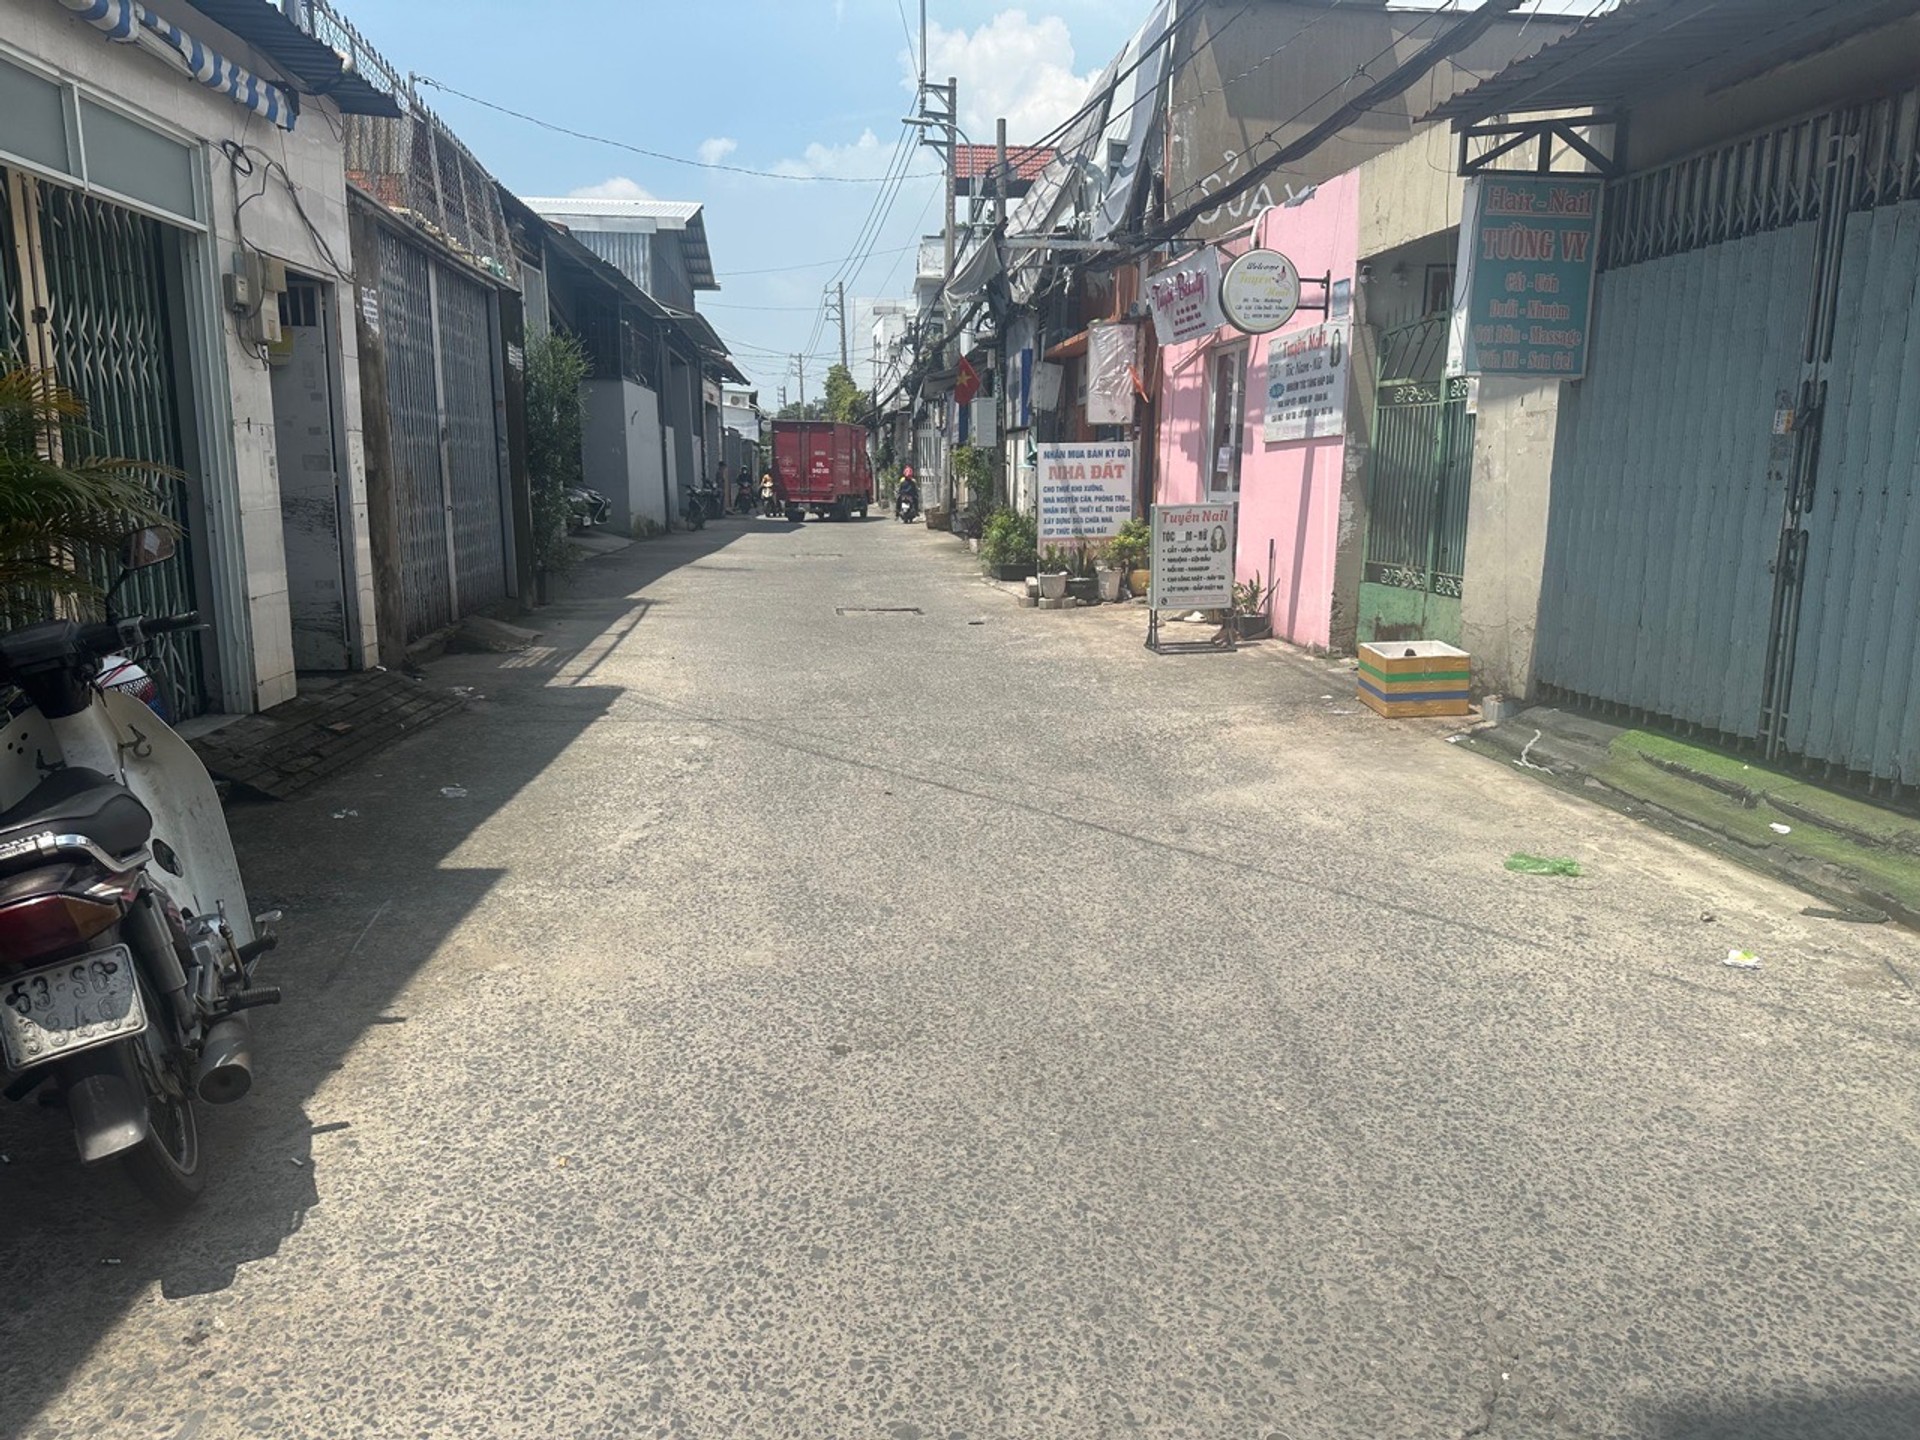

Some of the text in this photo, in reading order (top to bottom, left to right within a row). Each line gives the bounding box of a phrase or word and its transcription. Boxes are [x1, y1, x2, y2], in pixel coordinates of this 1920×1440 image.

[1485, 185, 1536, 213] Hair
[1547, 187, 1596, 215] Nail
[1560, 230, 1590, 262] VY
[1529, 325, 1582, 349] Massage
[1068, 449, 1086, 459] MUA
[1048, 459, 1125, 480] NHÀ ĐẤT
[1202, 509, 1229, 523] Nail
